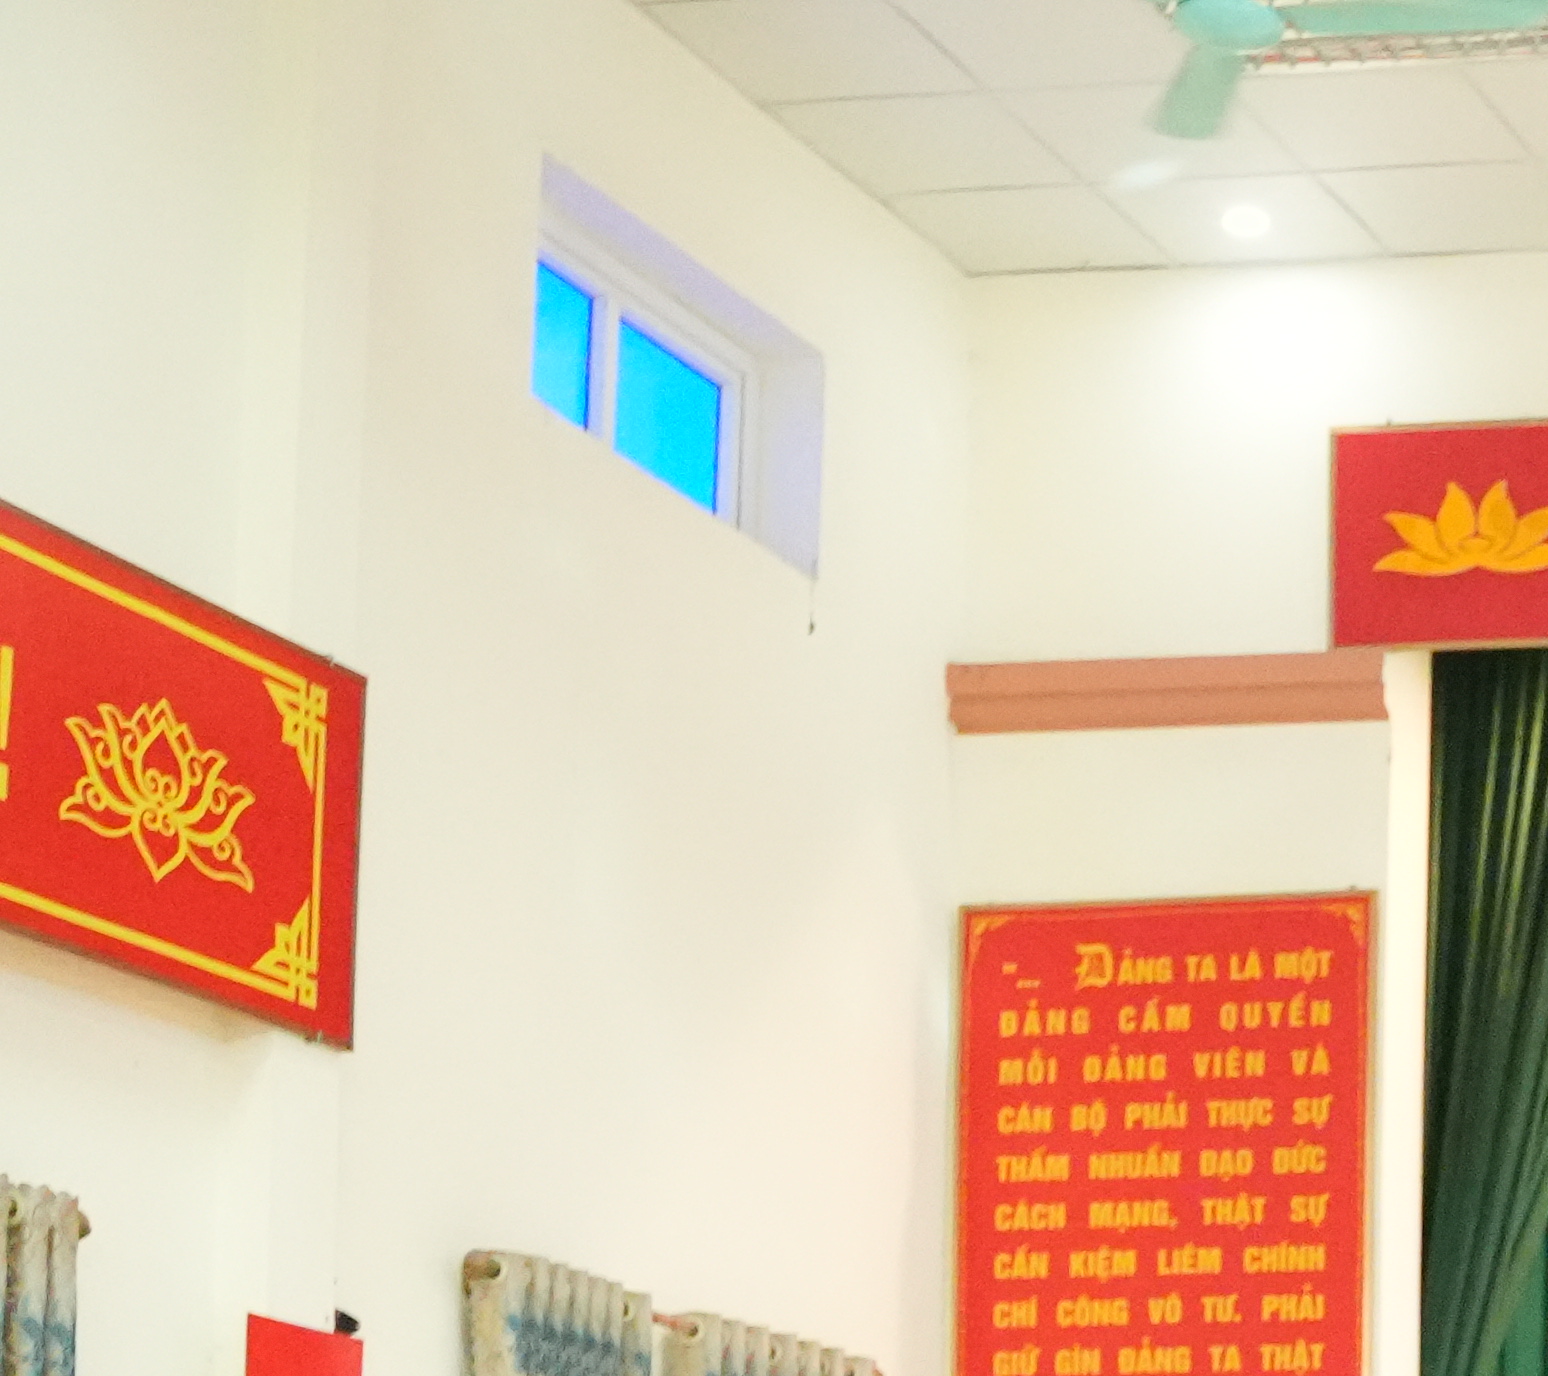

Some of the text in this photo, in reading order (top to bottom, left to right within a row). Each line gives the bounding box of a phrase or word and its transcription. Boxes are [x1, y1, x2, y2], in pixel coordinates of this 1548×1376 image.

[1076, 944, 1172, 988] ĐẢNG
[1186, 955, 1216, 981] TA
[1231, 951, 1262, 980] LÀ
[1275, 947, 1332, 983] MỘT
[1000, 1000, 1089, 1036] ĐẢNG
[1083, 1046, 1166, 1082] ĐẢNG
[1194, 1047, 1264, 1077] VIÊN
[1292, 1045, 1329, 1074] VÀ
[998, 1092, 1332, 1135] CÁN BỘ PHẢI THỰC SỰ
[1200, 1149, 1253, 1180] ĐẠO
[995, 1193, 1329, 1230] CÁCH THẬT SỰ
[1244, 1242, 1325, 1272] CHÍNH
[1057, 1295, 1129, 1327] CÔNG
[1149, 1293, 1182, 1323] VÔ
[1262, 1284, 1324, 1320] PHẢI
[1119, 1338, 1191, 1374] ĐẢNG
[1209, 1345, 1241, 1371] TA
[1261, 1339, 1324, 1375] THẬT
